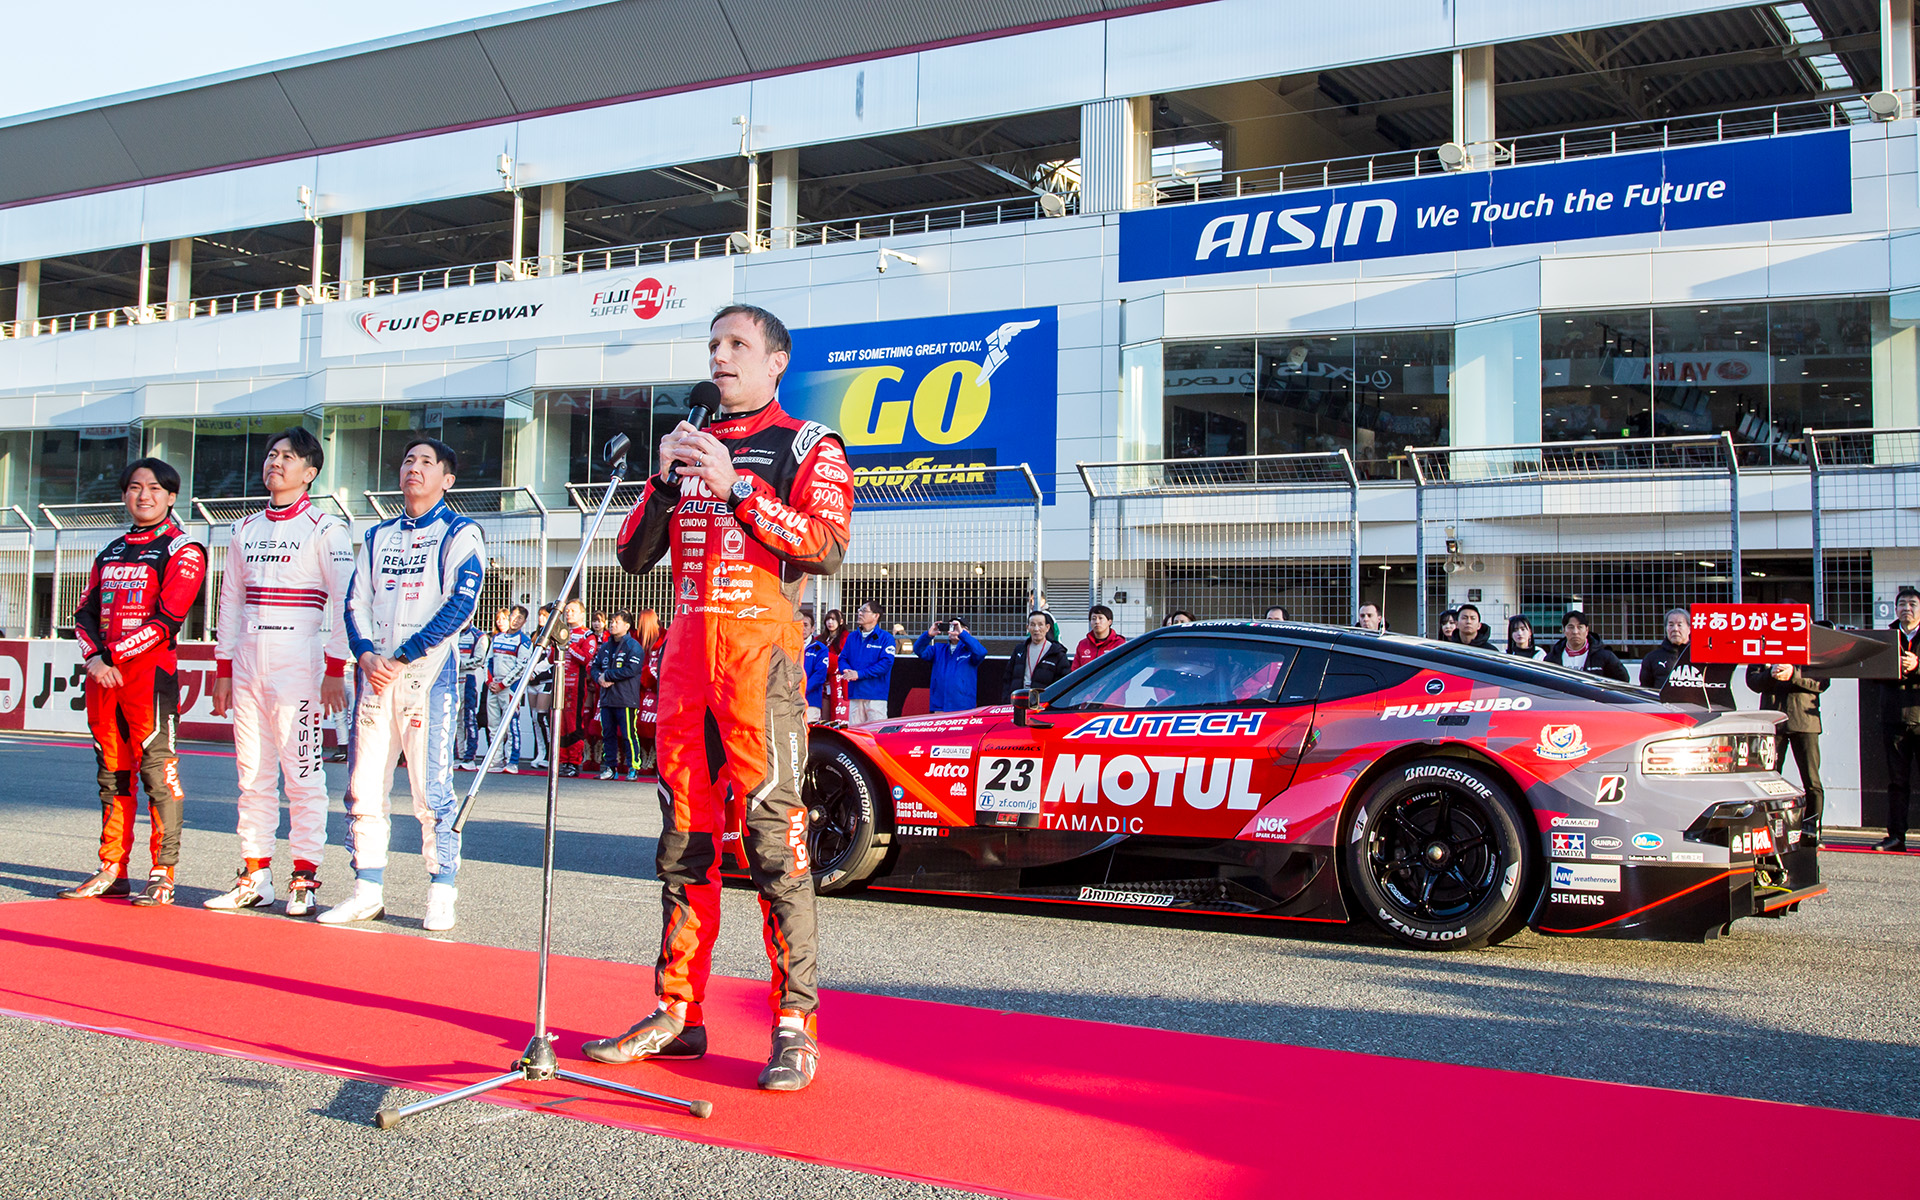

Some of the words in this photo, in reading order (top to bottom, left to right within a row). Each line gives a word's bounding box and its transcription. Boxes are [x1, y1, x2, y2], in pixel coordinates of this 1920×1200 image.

[1415, 204, 1458, 229] We
[1470, 196, 1554, 225] Touch
[1564, 188, 1612, 216] the
[1623, 179, 1727, 208] Future
[1195, 199, 1398, 261] AISIN
[590, 304, 628, 318] SUPER
[665, 298, 687, 310] TEC
[376, 316, 419, 333] FUJI
[828, 349, 857, 363] START
[858, 345, 914, 361] SOMETHING
[914, 342, 948, 357] GREAT
[949, 340, 982, 354] TODAY.
[839, 359, 991, 446] GO
[715, 425, 747, 435] NISSAN
[820, 463, 845, 480] Arai
[853, 458, 987, 490] OODYEAR
[755, 495, 808, 534] MOTUL
[747, 508, 804, 547] AUTECH
[244, 540, 300, 550] NISSAN
[246, 554, 291, 563] nismo
[101, 565, 149, 580] MOTUL
[101, 579, 149, 590] AUTECH
[1878, 603, 1889, 617] 9
[1691, 611, 1807, 632] #ありがとう
[115, 626, 158, 652] MOTUL
[1742, 639, 1806, 656] ロニー
[1669, 664, 1703, 680] MAC
[1669, 680, 1704, 688] TOOLS
[1380, 697, 1533, 721] FUJITSUBO
[905, 720, 934, 728] NISMO
[934, 718, 969, 727] SPORTS
[969, 717, 984, 725] OIL
[1063, 711, 1267, 739] AUTECH
[298, 699, 309, 779] NISSAN
[924, 762, 970, 778] Jatco
[984, 758, 1035, 792] 23
[836, 752, 871, 824] BRIDGESTONE
[1043, 753, 1262, 810] MOTUL
[1405, 765, 1493, 800] BRIDGESTONE
[896, 801, 914, 810] Asset
[980, 794, 993, 806] ZF
[998, 798, 1038, 811] zf.com/jp
[896, 809, 911, 818] Auto
[912, 809, 938, 819] Service
[1043, 813, 1144, 834] TAMADIC
[1256, 817, 1288, 833] NGK
[1560, 819, 1597, 827] TAMACHI
[897, 825, 950, 838] nismo
[1593, 839, 1620, 847] SUNRAY
[1552, 849, 1584, 857] TAMIYA
[1555, 871, 1573, 882] WN
[1574, 876, 1617, 884] weathernews
[1078, 886, 1175, 907] BRIDGESTONE
[1550, 892, 1605, 905] SIEMENS
[1378, 907, 1468, 942] POTENZA
